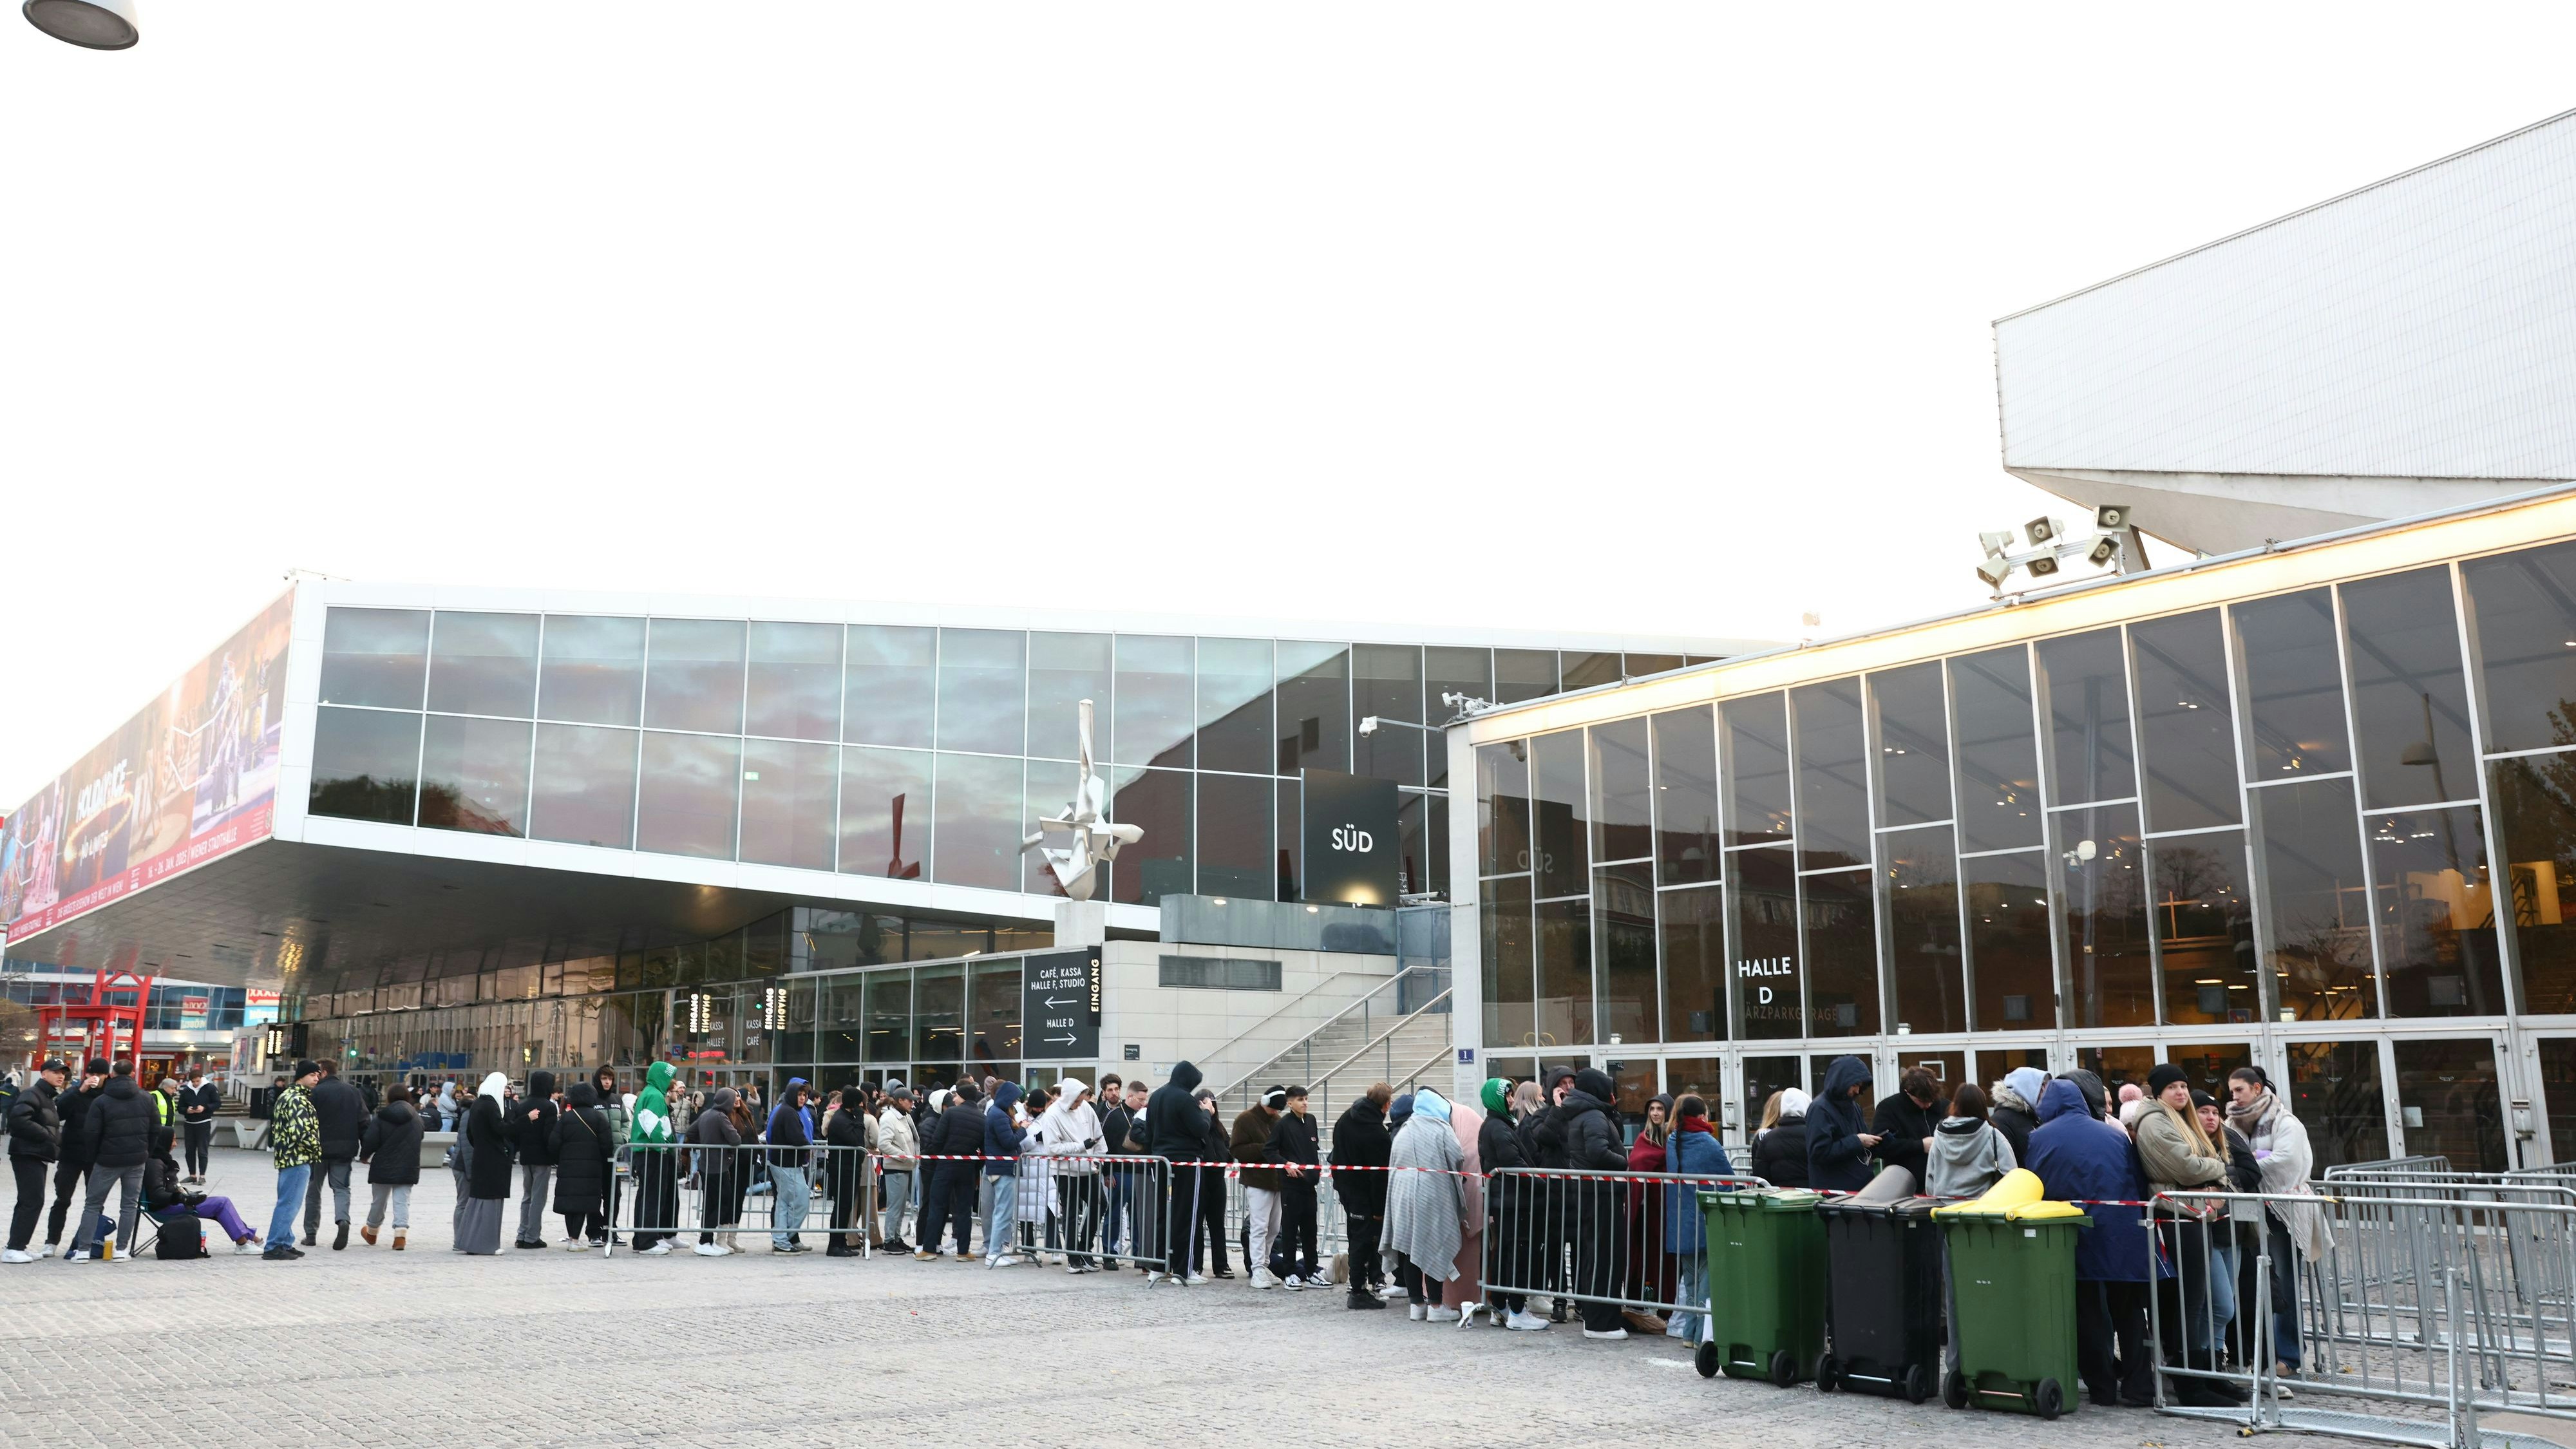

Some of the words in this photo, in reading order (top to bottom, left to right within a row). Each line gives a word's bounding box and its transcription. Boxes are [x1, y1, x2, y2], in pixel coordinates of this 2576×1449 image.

[1332, 823, 1373, 853] SÜD
[1040, 967, 1058, 979] CAFÉ,
[1060, 967, 1082, 977] KASSA
[1738, 956, 1792, 978] HALLE
[1031, 981, 1050, 990] HALLE
[1052, 980, 1057, 990] F,
[1059, 978, 1085, 989] STUDIO
[1091, 959, 1099, 1012] EINGANG
[1759, 987, 1773, 1005] D
[690, 993, 699, 1033] EINGANG
[765, 988, 774, 1030] EINGANG
[1746, 1001, 1837, 1021] ÄRZPARKGRAGE
[709, 1021, 724, 1030] KASSA
[746, 1019, 762, 1028] KASSA
[1046, 1018, 1066, 1028] HALLE
[1068, 1018, 1074, 1027] D
[706, 1037, 721, 1047] HALLE
[721, 1037, 725, 1046] F
[746, 1034, 759, 1046] CAFÉ
[1463, 1050, 1468, 1059] 1
